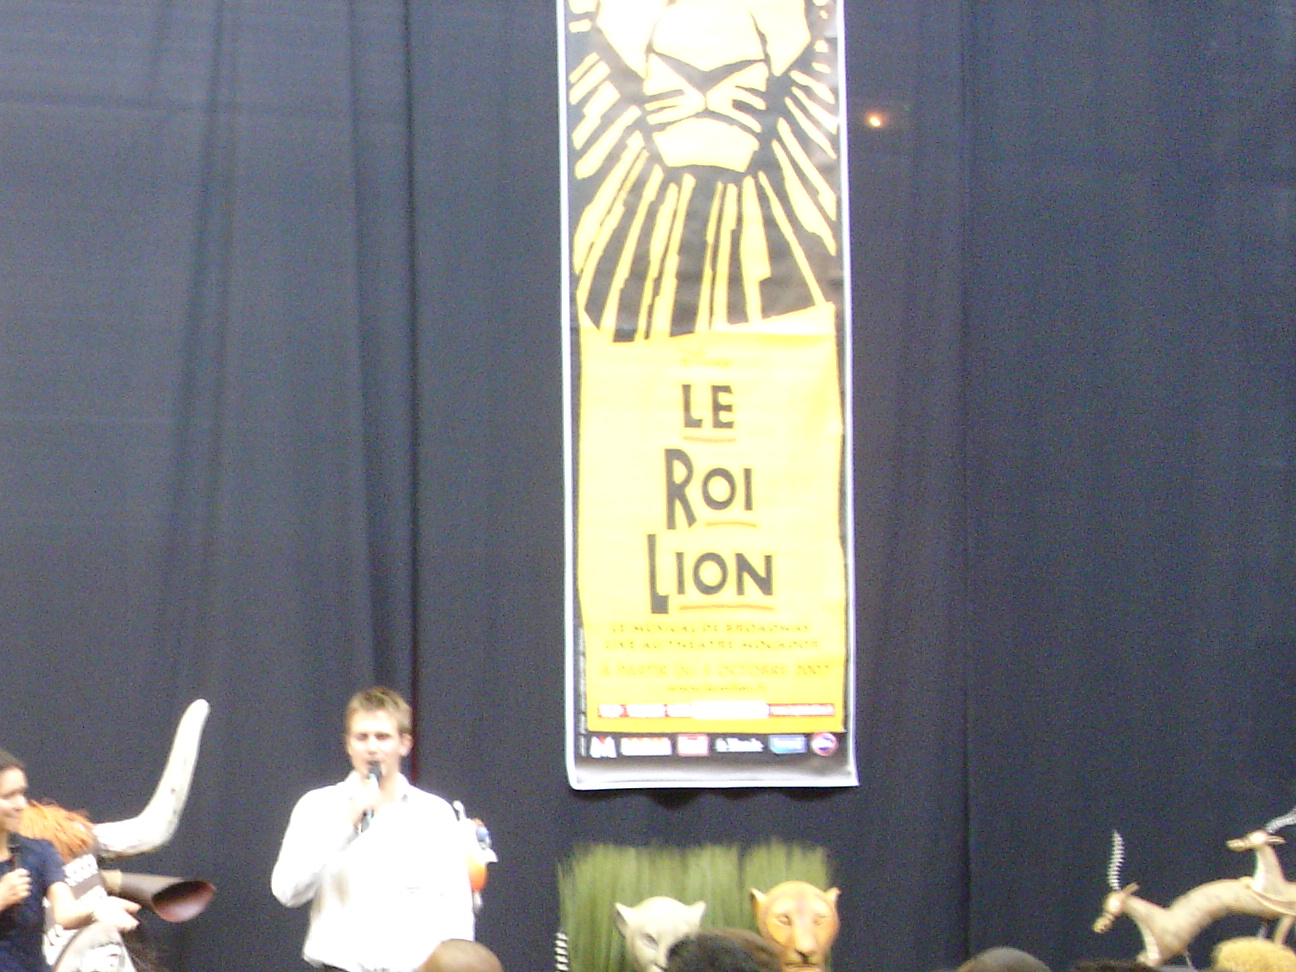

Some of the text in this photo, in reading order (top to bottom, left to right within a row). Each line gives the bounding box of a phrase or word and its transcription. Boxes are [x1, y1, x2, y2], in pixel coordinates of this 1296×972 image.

[682, 384, 735, 429] LE
[664, 448, 754, 530] ROI
[647, 533, 774, 614] LION
